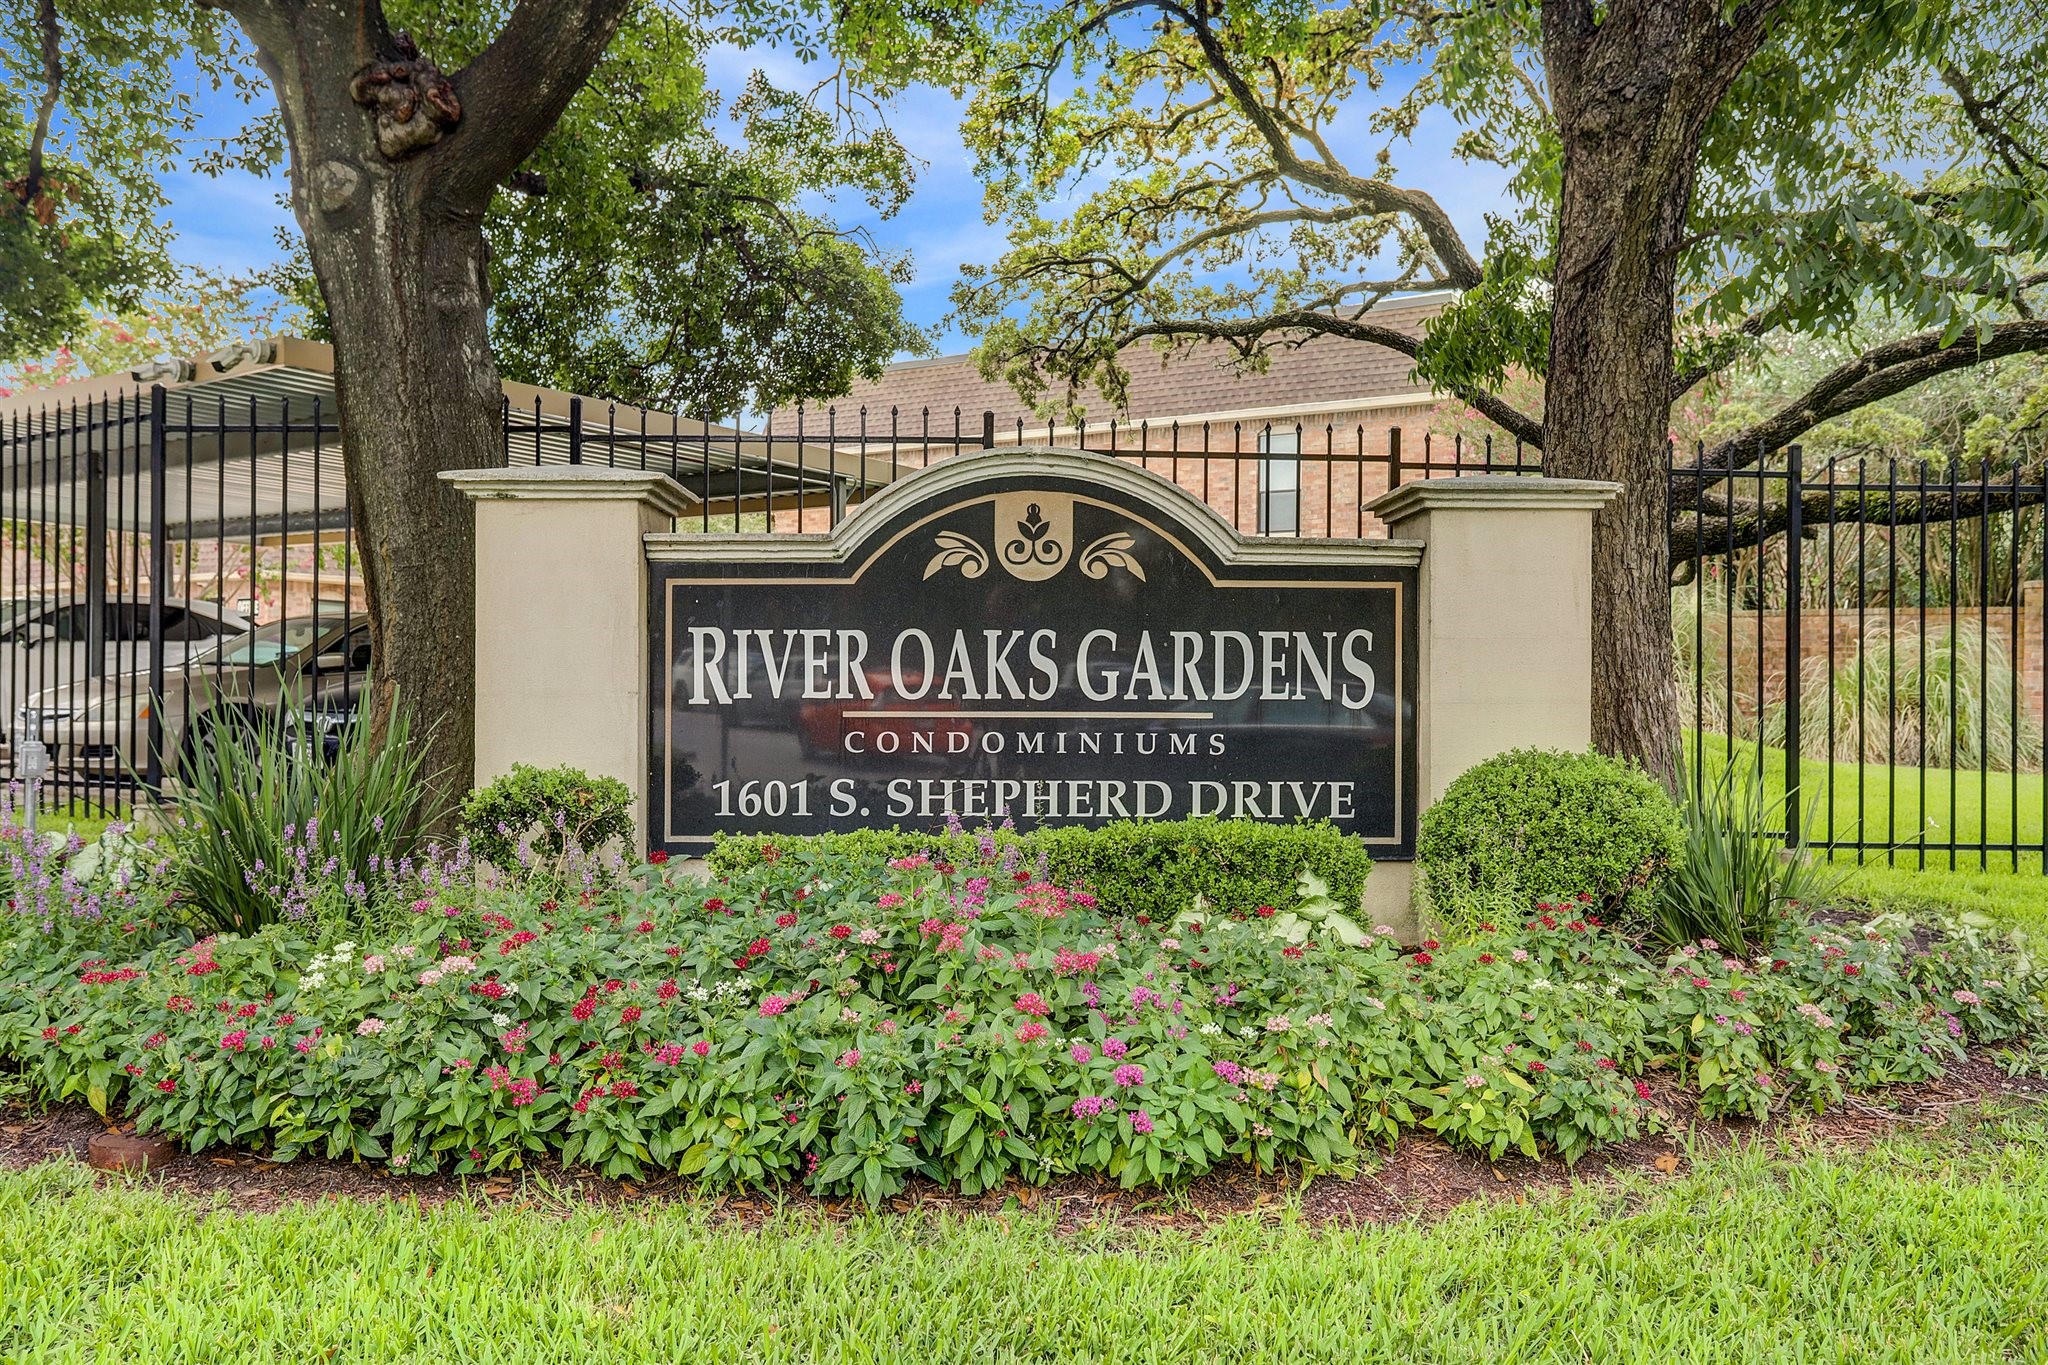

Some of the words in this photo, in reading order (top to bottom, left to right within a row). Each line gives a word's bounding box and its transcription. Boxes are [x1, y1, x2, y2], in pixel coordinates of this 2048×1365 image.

[687, 626, 875, 705] RIVER
[890, 628, 1059, 701] OAKS
[1076, 629, 1375, 710] GARDENS
[844, 731, 1225, 756] CONDOMINIUMS
[712, 779, 813, 817] 1601
[829, 778, 870, 817] S.
[886, 779, 1173, 818] SHEPHERD
[1188, 780, 1355, 819] DRIVE
